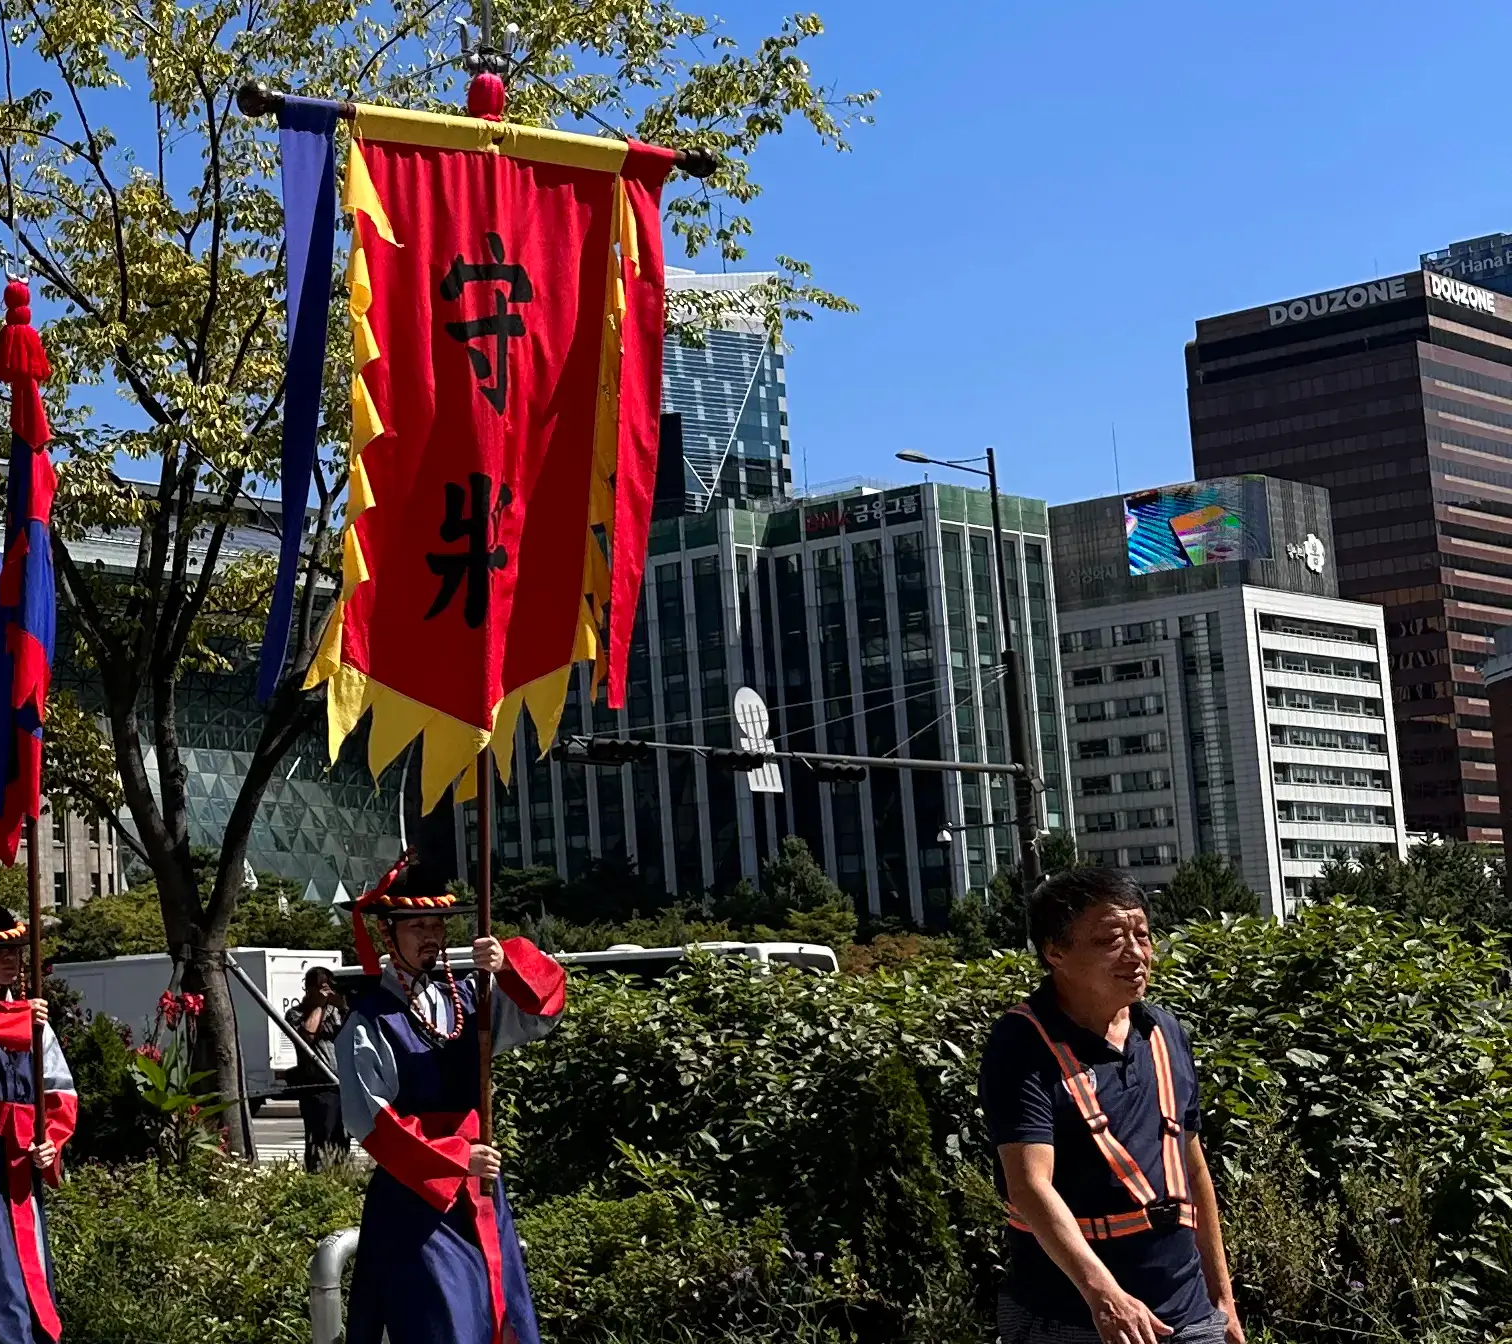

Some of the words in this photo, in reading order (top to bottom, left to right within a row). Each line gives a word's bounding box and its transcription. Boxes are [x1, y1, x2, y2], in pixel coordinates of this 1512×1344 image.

[1460, 255, 1504, 275] Hana
[1268, 277, 1407, 326] DOUZONE
[1430, 274, 1496, 314] DOUZONE
[852, 493, 921, 524] 금융그룹
